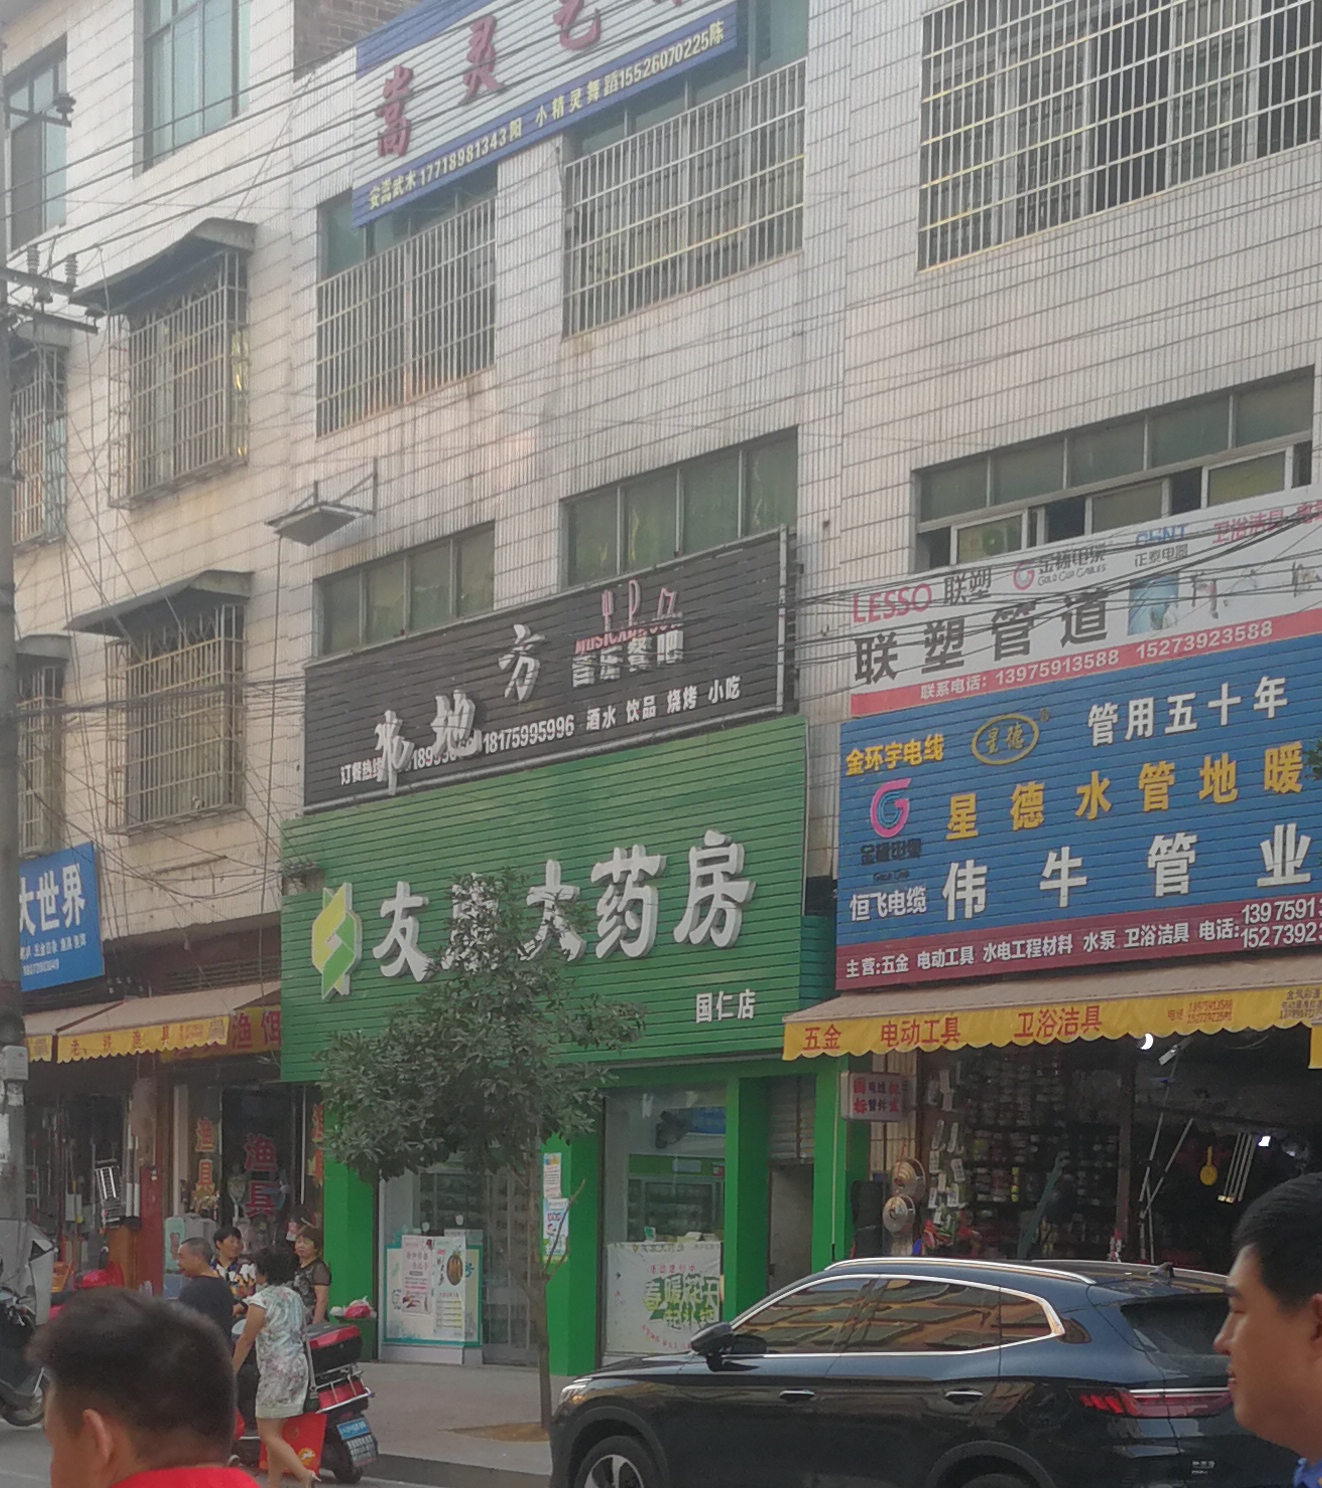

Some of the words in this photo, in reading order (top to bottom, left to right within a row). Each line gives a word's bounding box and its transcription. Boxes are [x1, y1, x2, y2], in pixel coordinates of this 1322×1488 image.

[853, 583, 932, 624] LESSO
[854, 588, 1109, 684] 联塑管道
[995, 650, 1120, 685] 13975913588
[1136, 620, 1273, 659] 15273923588
[626, 695, 657, 723] 饮品
[708, 675, 741, 704] 小吃
[1087, 676, 1289, 747] 管用五十年
[845, 733, 945, 777] 金环宇电线
[946, 741, 1305, 841] 星德水管地暖
[942, 824, 1312, 922] 伟牛管业
[849, 886, 927, 922] 恒飞电缆
[917, 946, 974, 973] 电动工具
[982, 934, 1074, 965] 水电工程材料
[1083, 926, 1116, 952] 水泵
[1123, 920, 1189, 948] 卫浴洁具
[695, 989, 757, 1024] 国仁店
[802, 1026, 842, 1050] 五金
[880, 1016, 961, 1047] 电动工具
[1014, 1006, 1102, 1041] 卫浴洁具
